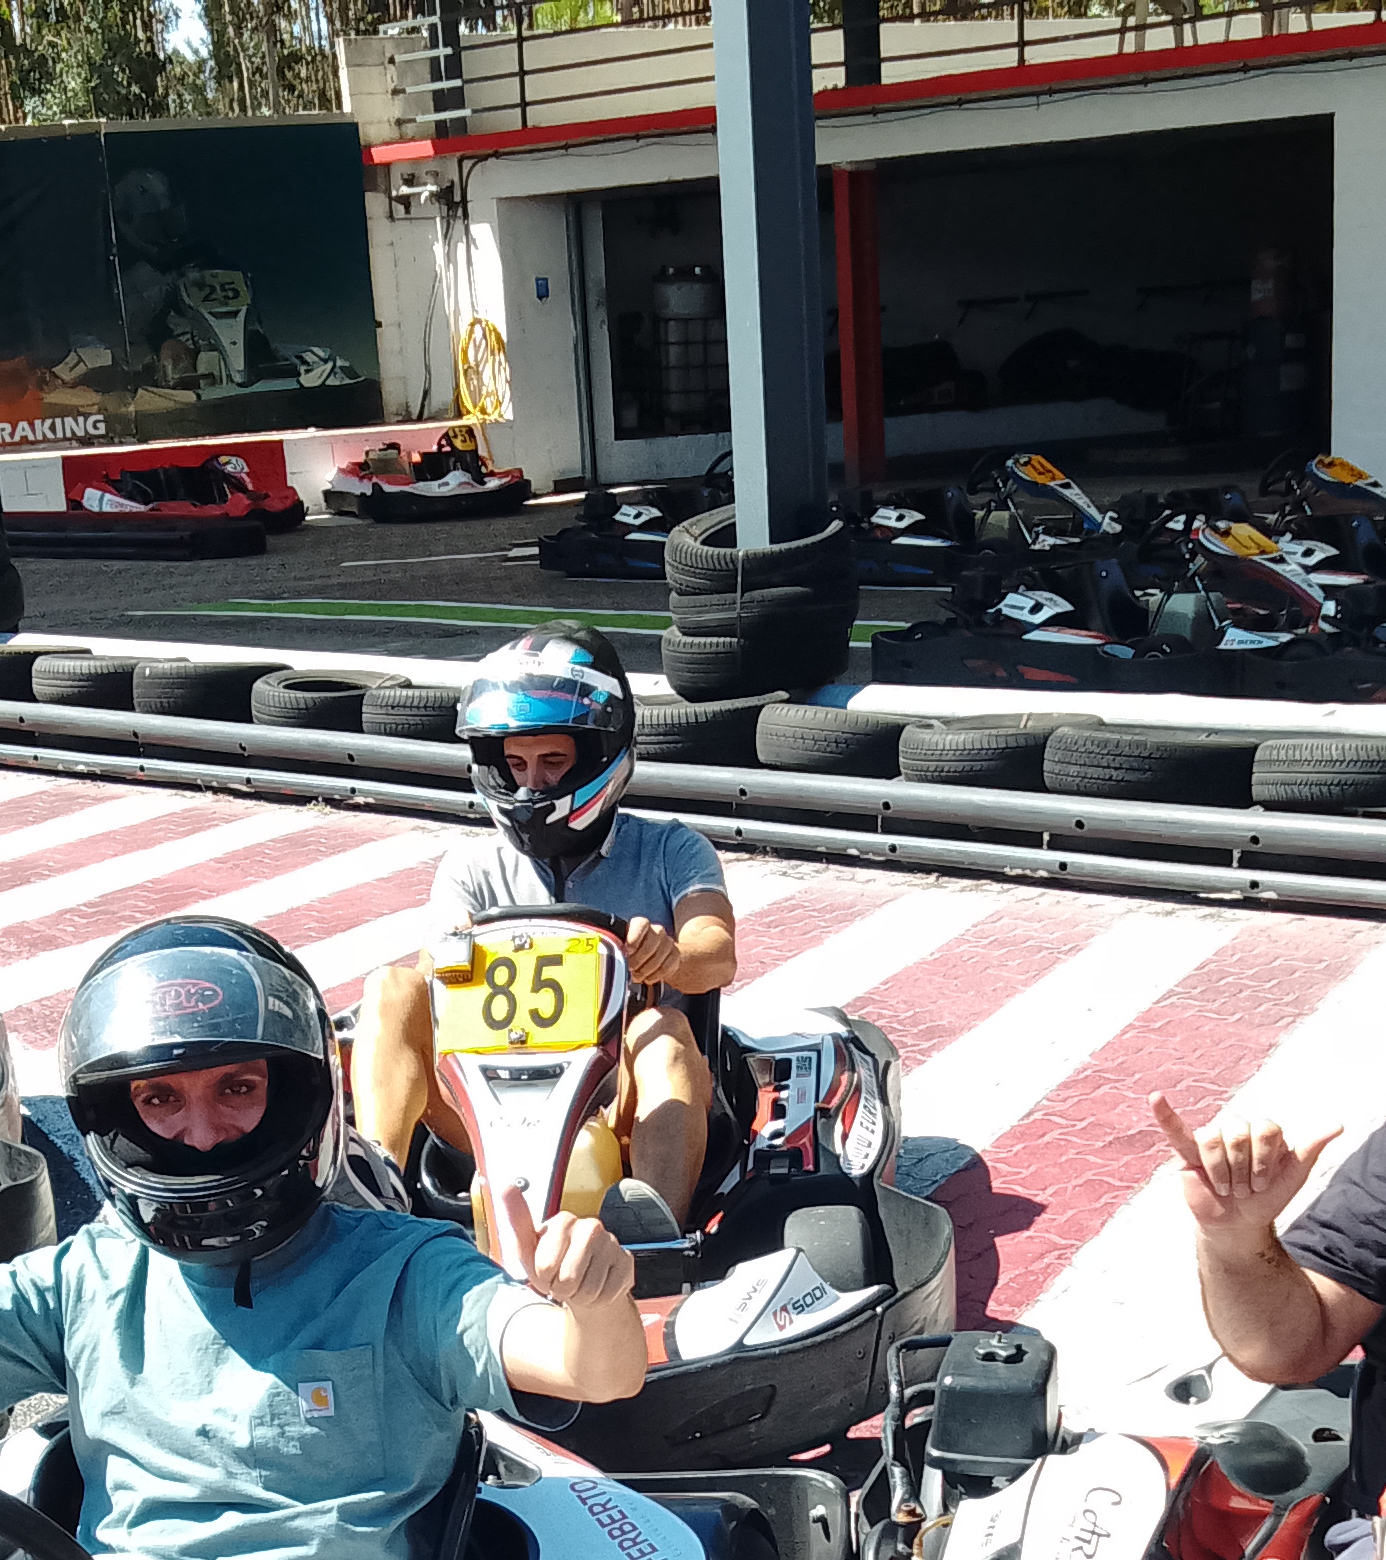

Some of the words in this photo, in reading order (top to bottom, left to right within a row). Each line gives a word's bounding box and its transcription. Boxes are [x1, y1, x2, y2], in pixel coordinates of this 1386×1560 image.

[203, 281, 241, 303] 25
[482, 954, 565, 1030] 85
[792, 1281, 828, 1315] SODI
